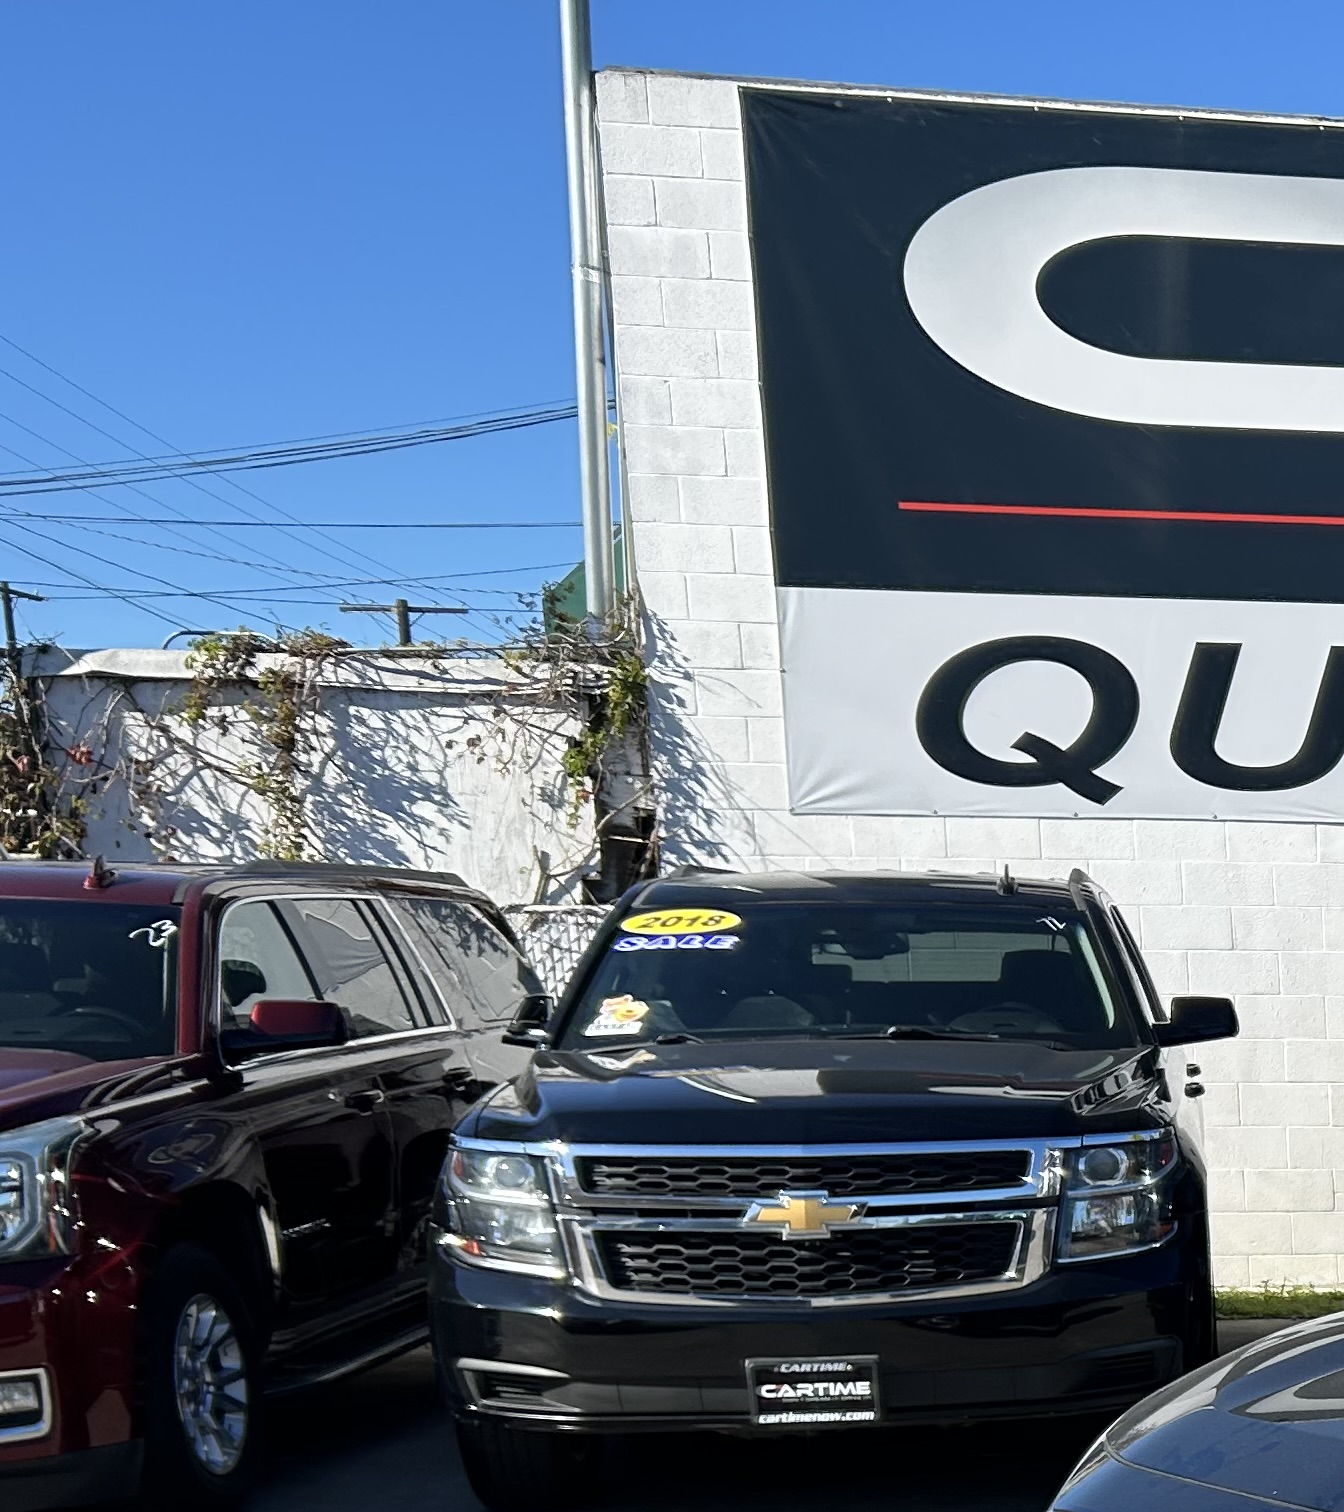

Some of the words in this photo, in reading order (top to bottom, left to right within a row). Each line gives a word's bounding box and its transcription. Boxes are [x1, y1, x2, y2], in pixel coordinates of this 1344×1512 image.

[635, 915, 727, 929] 2018
[613, 934, 741, 951] SALE
[758, 1381, 872, 1398] CARTIME
[758, 1410, 875, 1424] cartimenow.com
